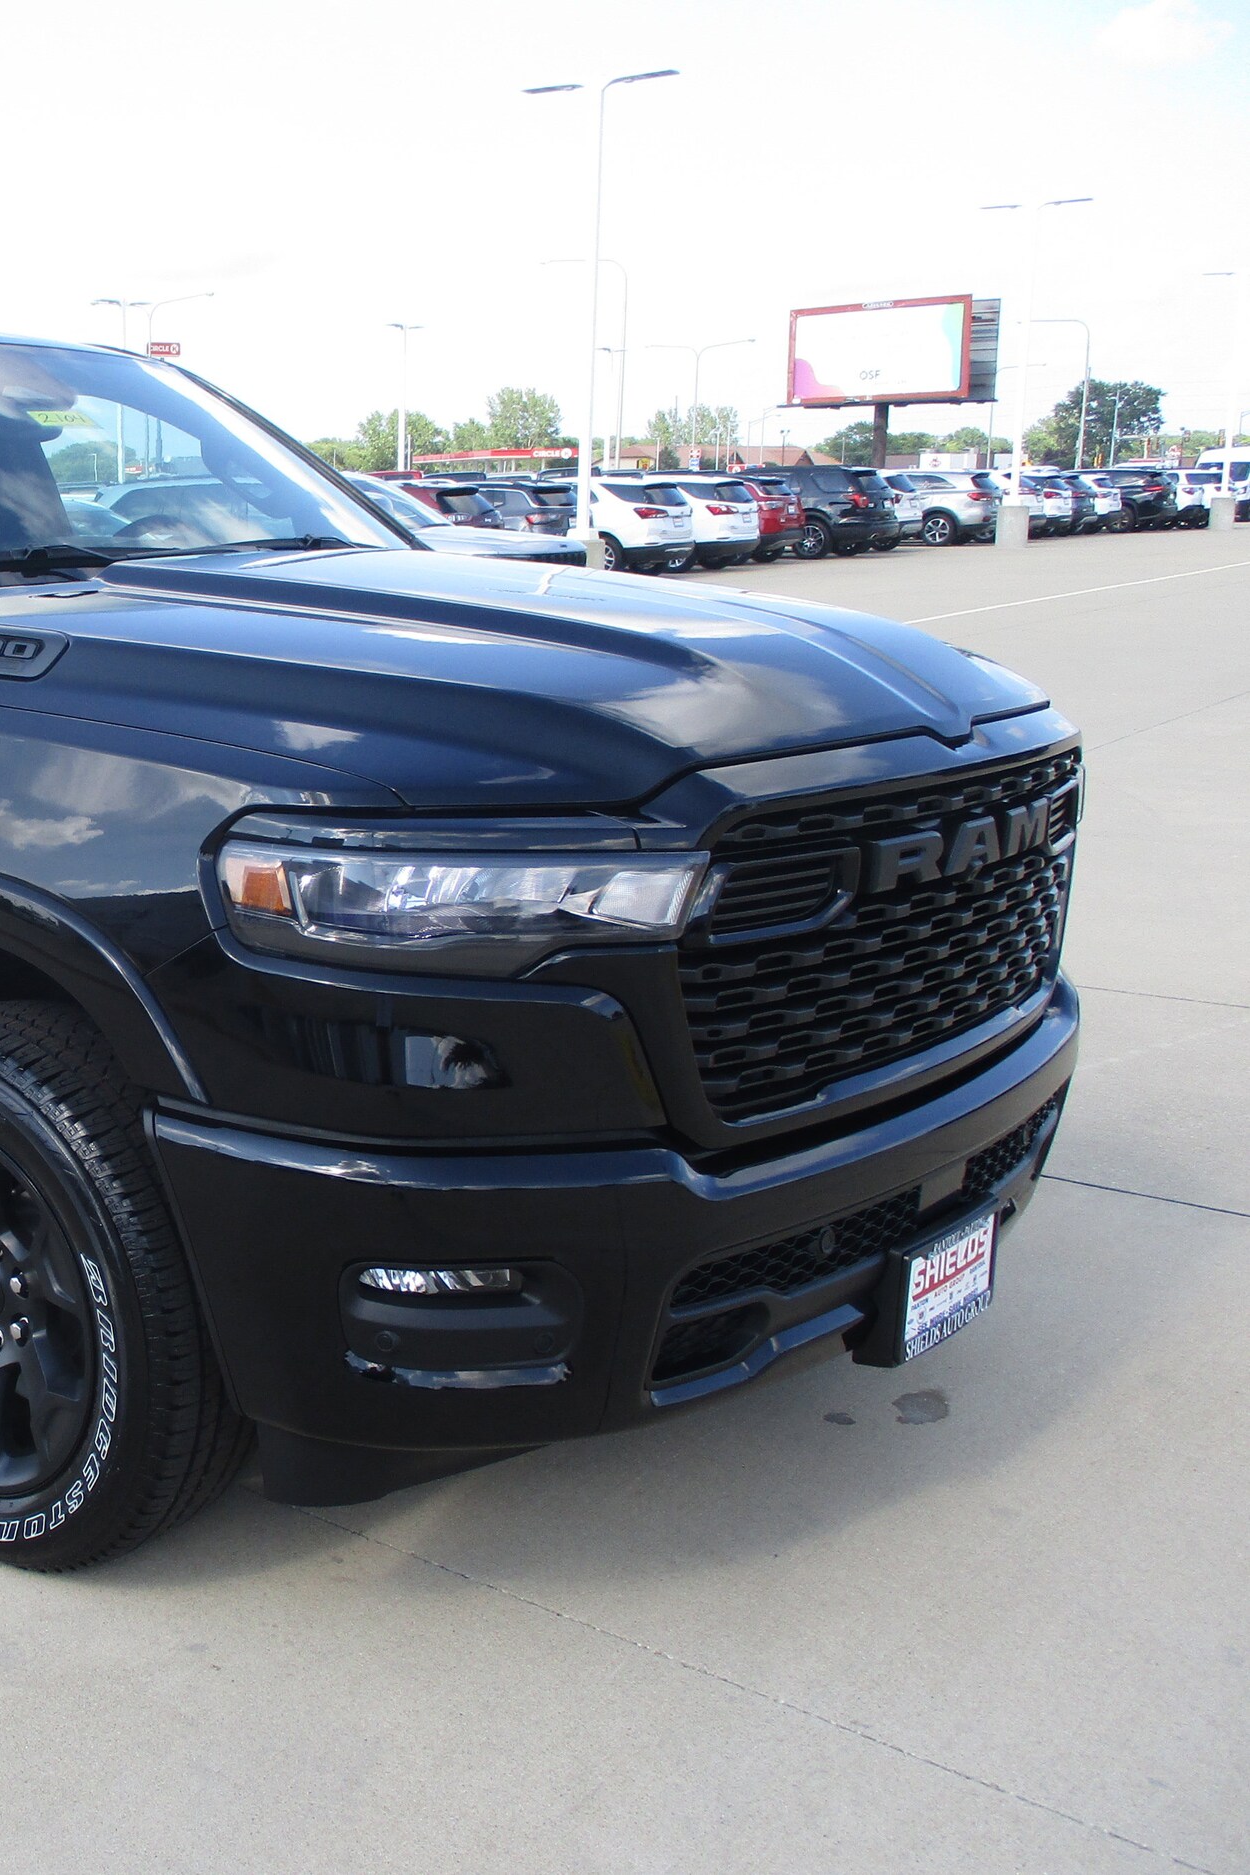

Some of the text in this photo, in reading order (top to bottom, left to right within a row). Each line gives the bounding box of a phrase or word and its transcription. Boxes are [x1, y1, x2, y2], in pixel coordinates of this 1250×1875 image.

[859, 369, 881, 381] OSF
[532, 450, 560, 458] CIRCLE
[868, 797, 1049, 894] RAM
[912, 1229, 988, 1294] SHIELDS
[934, 1284, 948, 1298] AUTO
[905, 1323, 941, 1361] SHIELDS
[940, 1308, 965, 1339] AUTO
[964, 1290, 992, 1323] GROUP
